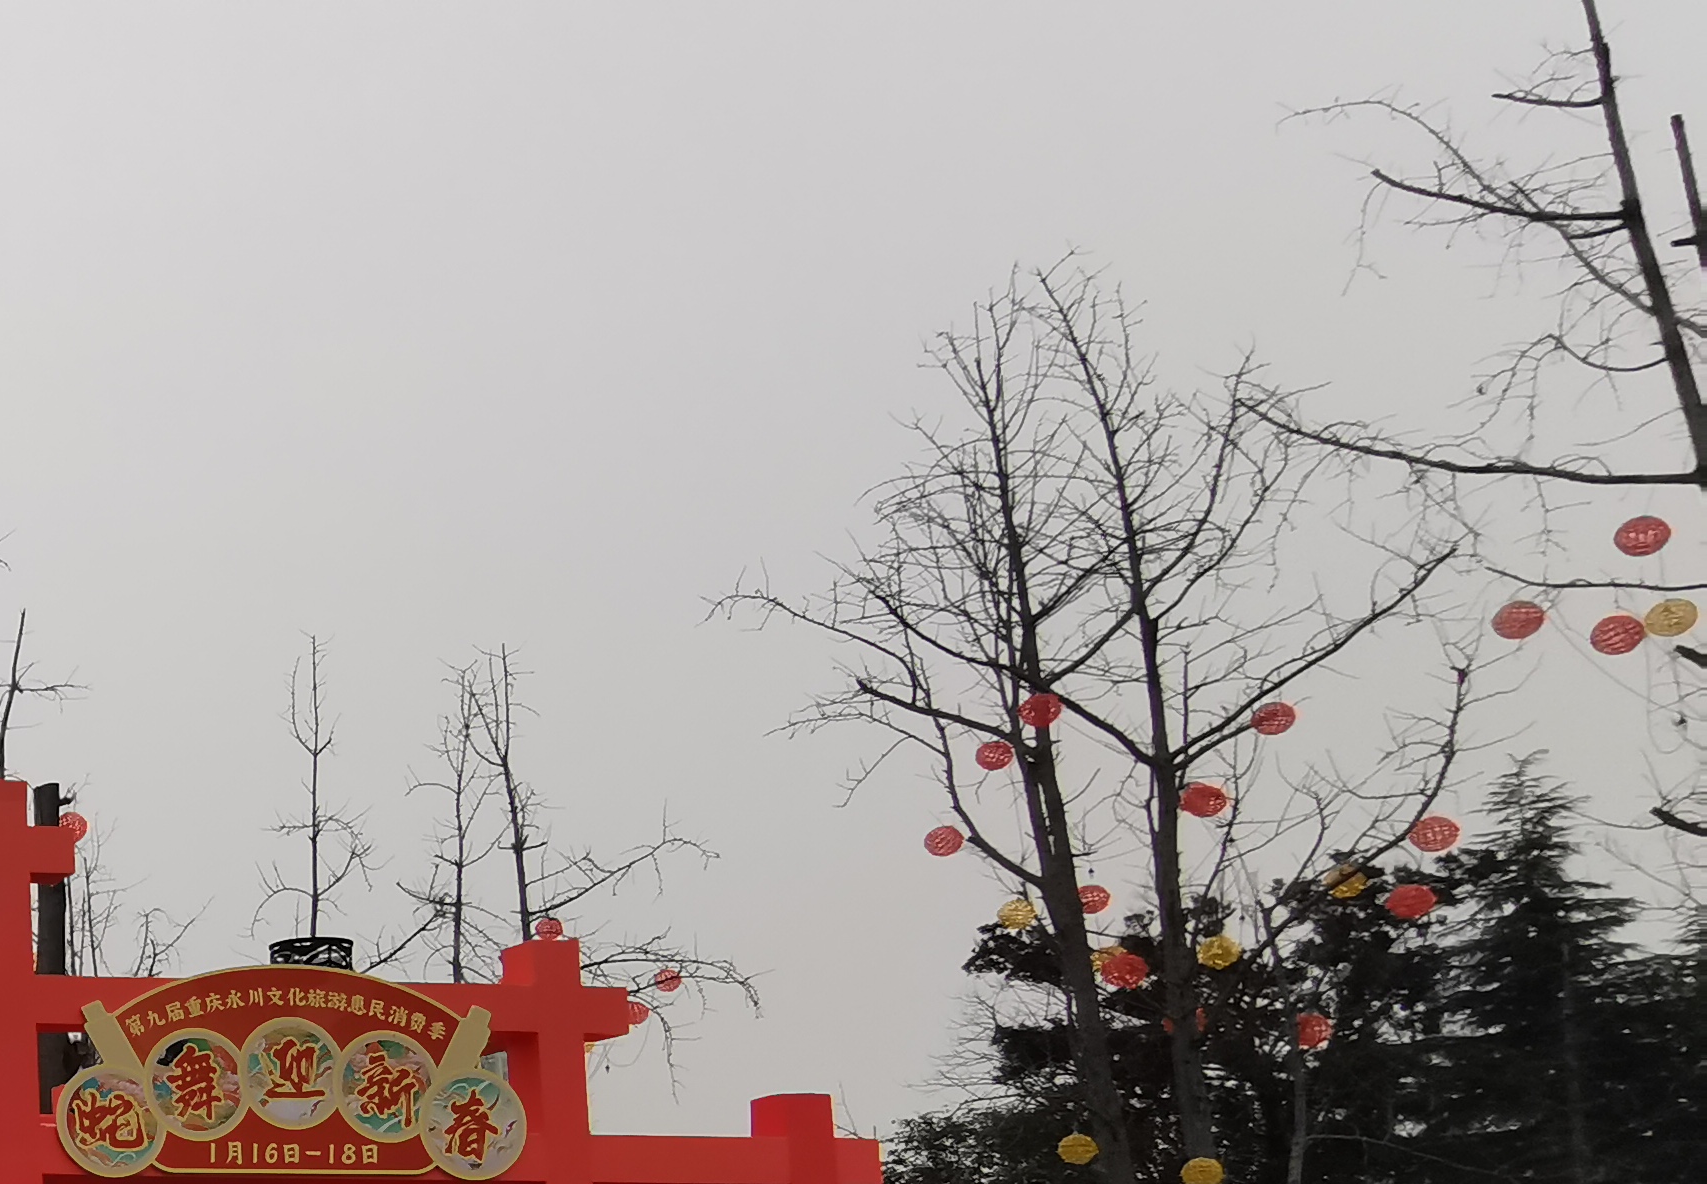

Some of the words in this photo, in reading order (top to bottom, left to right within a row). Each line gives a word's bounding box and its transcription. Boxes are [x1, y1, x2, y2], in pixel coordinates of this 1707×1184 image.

[125, 987, 448, 1041] 第九届重庆永川文化旅游惠民消费季
[72, 1035, 502, 1163] 蛇舞迎新春
